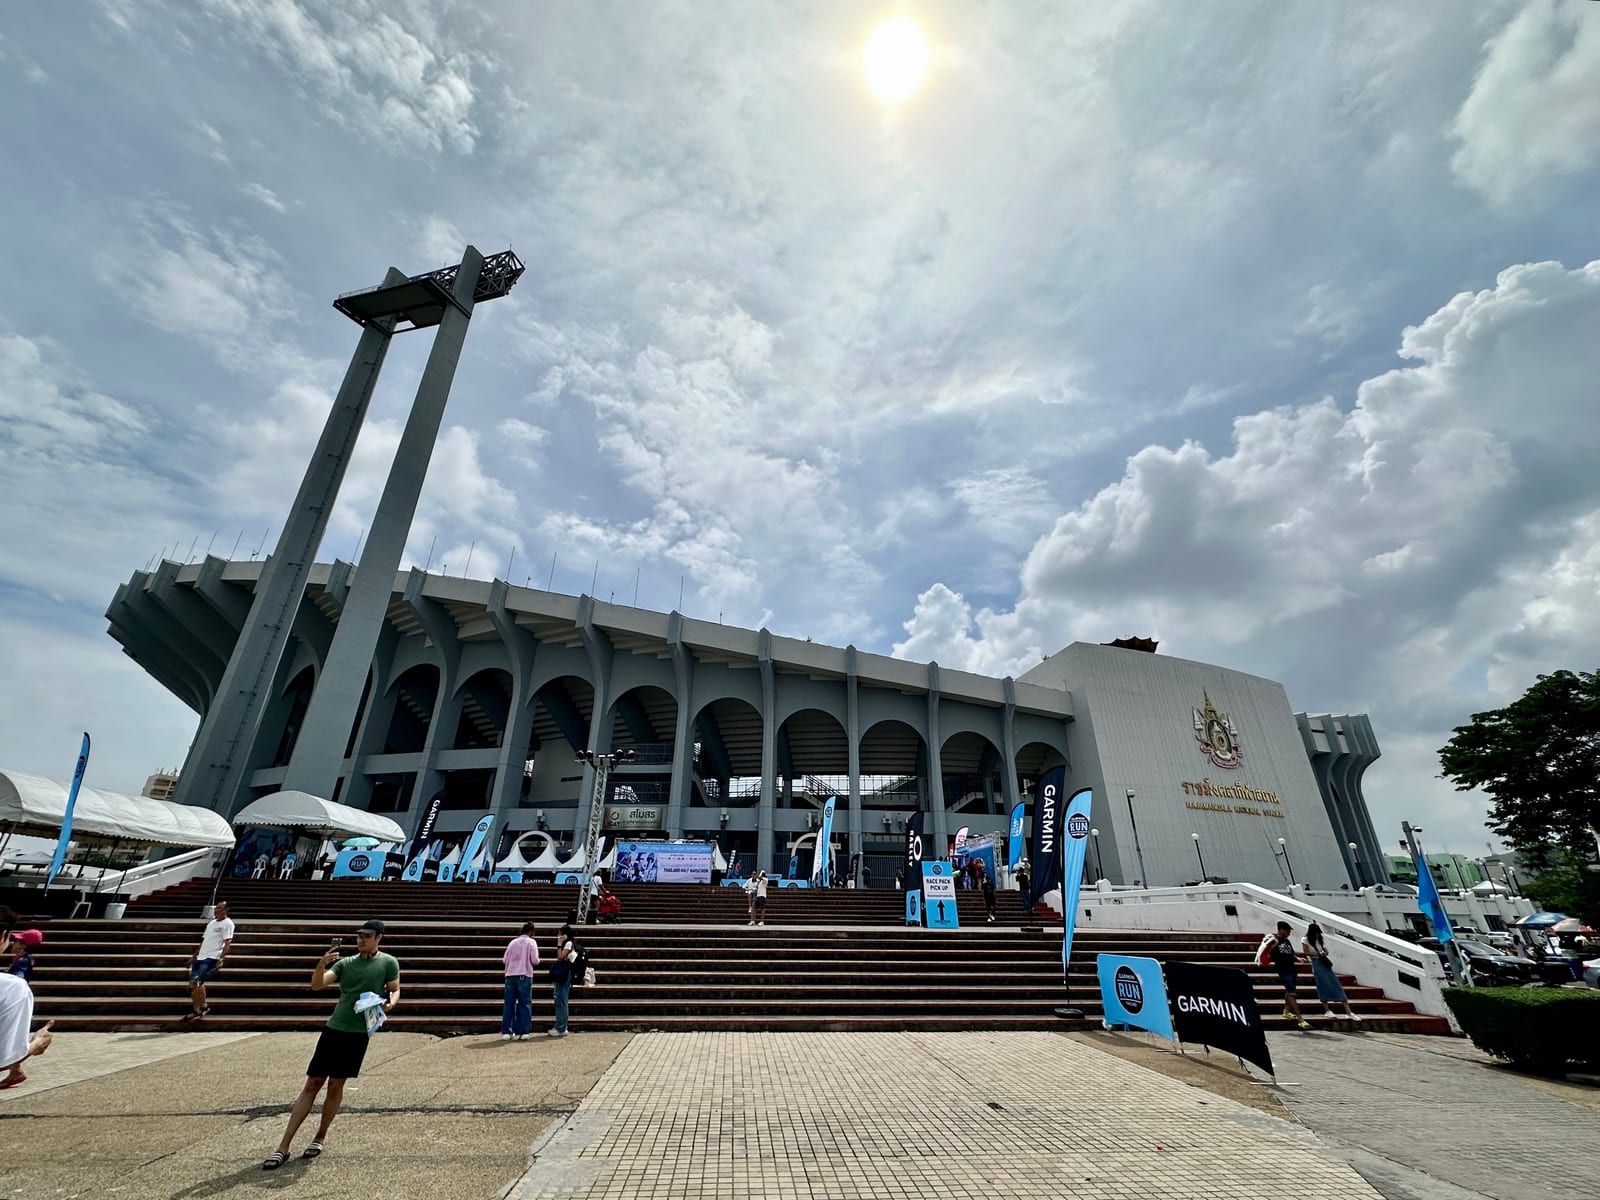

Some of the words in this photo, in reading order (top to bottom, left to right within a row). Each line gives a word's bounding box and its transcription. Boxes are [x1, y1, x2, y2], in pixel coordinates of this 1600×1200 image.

[420, 799, 440, 839] GARMIN
[629, 808, 656, 819] สโมสร
[1041, 784, 1056, 853] GARMIN
[1069, 821, 1088, 831] RUN
[1118, 983, 1141, 1000] RUN
[1177, 995, 1248, 1026] GARMIN
